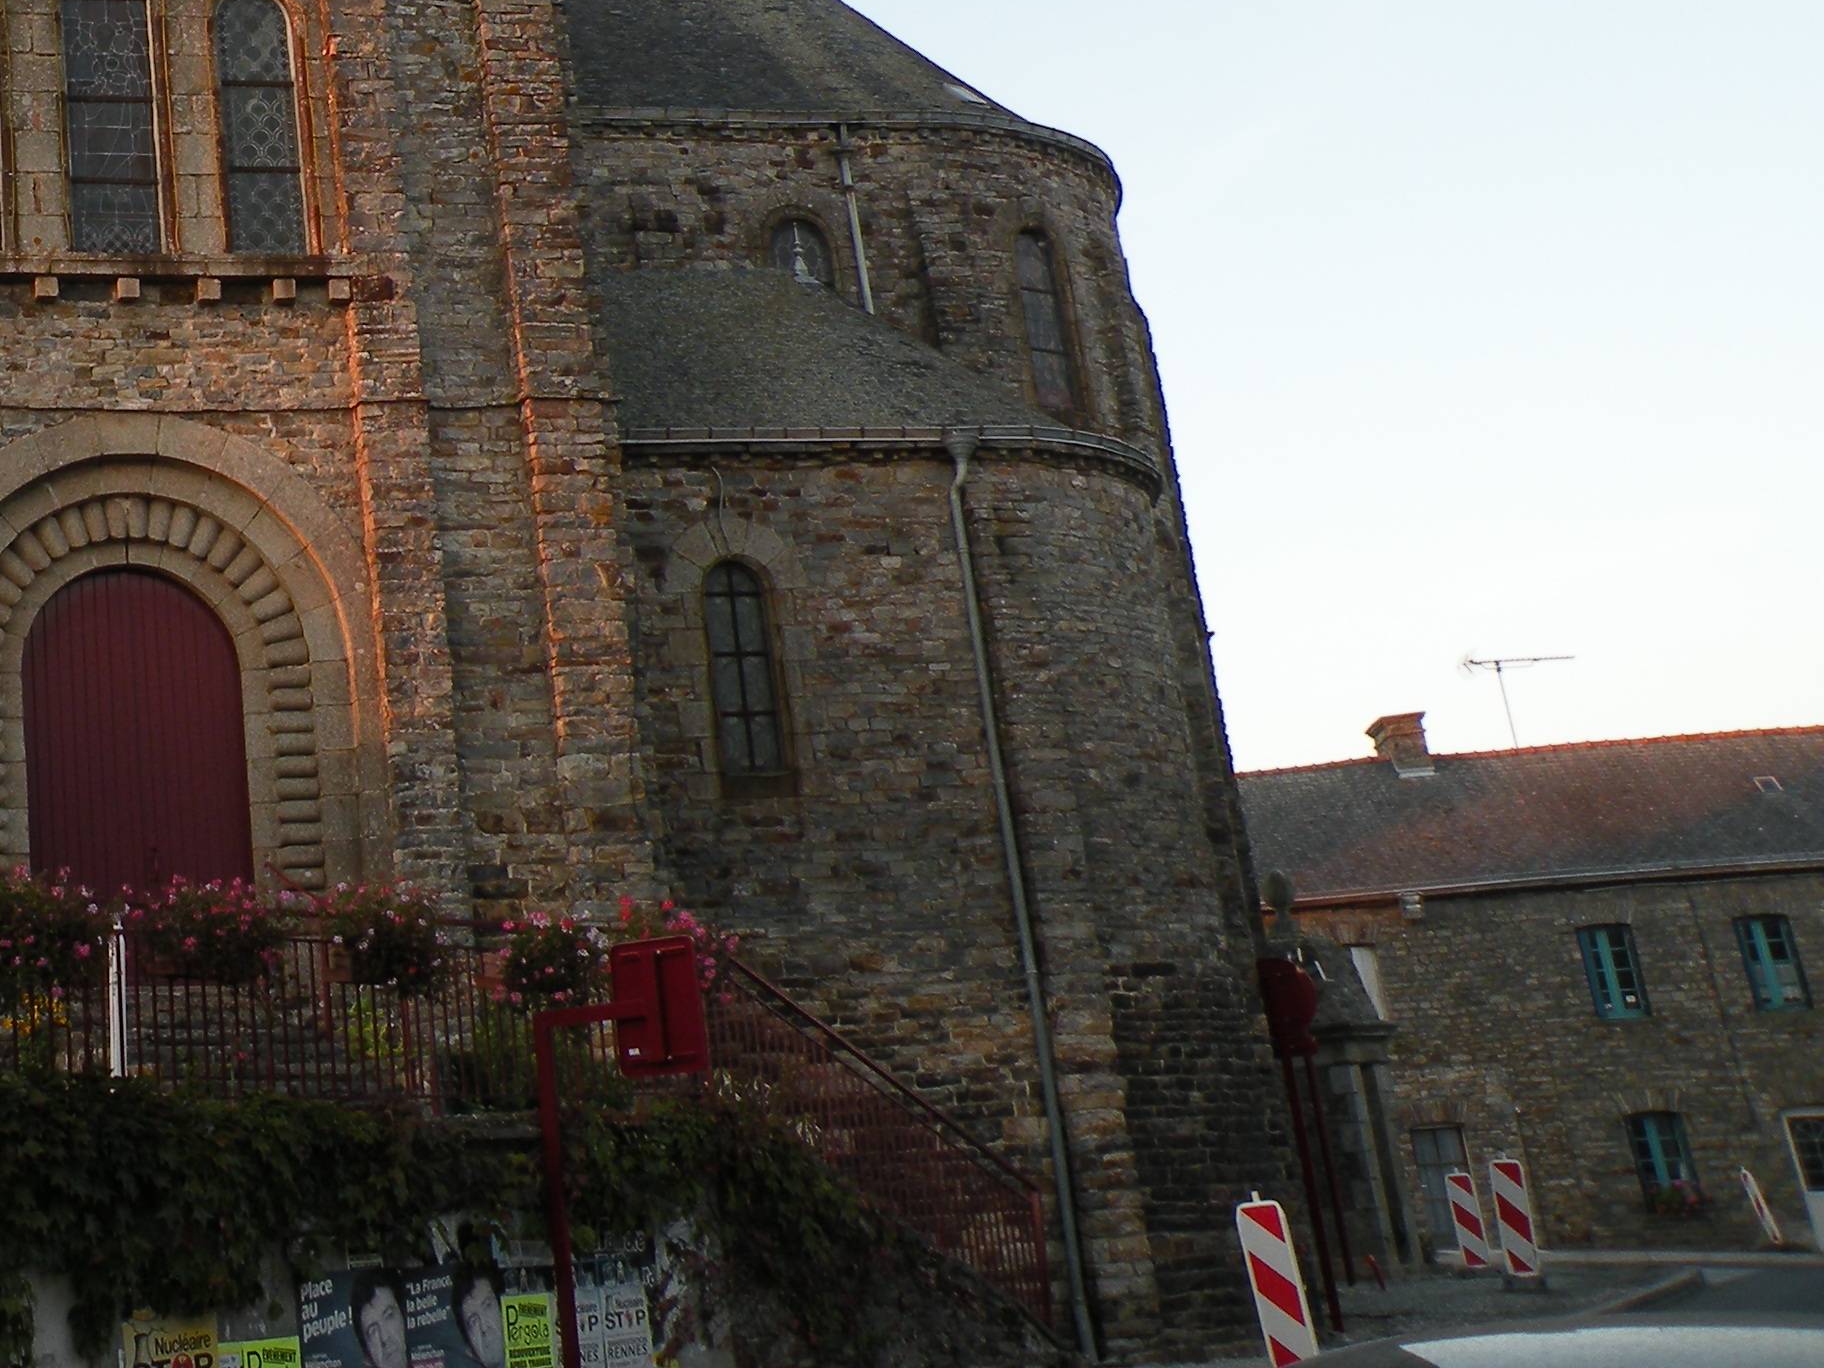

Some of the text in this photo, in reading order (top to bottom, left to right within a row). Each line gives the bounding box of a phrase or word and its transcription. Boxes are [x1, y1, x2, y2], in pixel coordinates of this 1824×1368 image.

[300, 1278, 333, 1302] Place
[301, 1302, 319, 1320] au
[406, 1294, 438, 1312] la belle
[302, 1308, 346, 1343] peuple
[406, 1316, 416, 1330] la
[506, 1304, 549, 1346] Pergola
[154, 1331, 212, 1356] Nucléaire
[608, 1343, 649, 1360] RENNES
